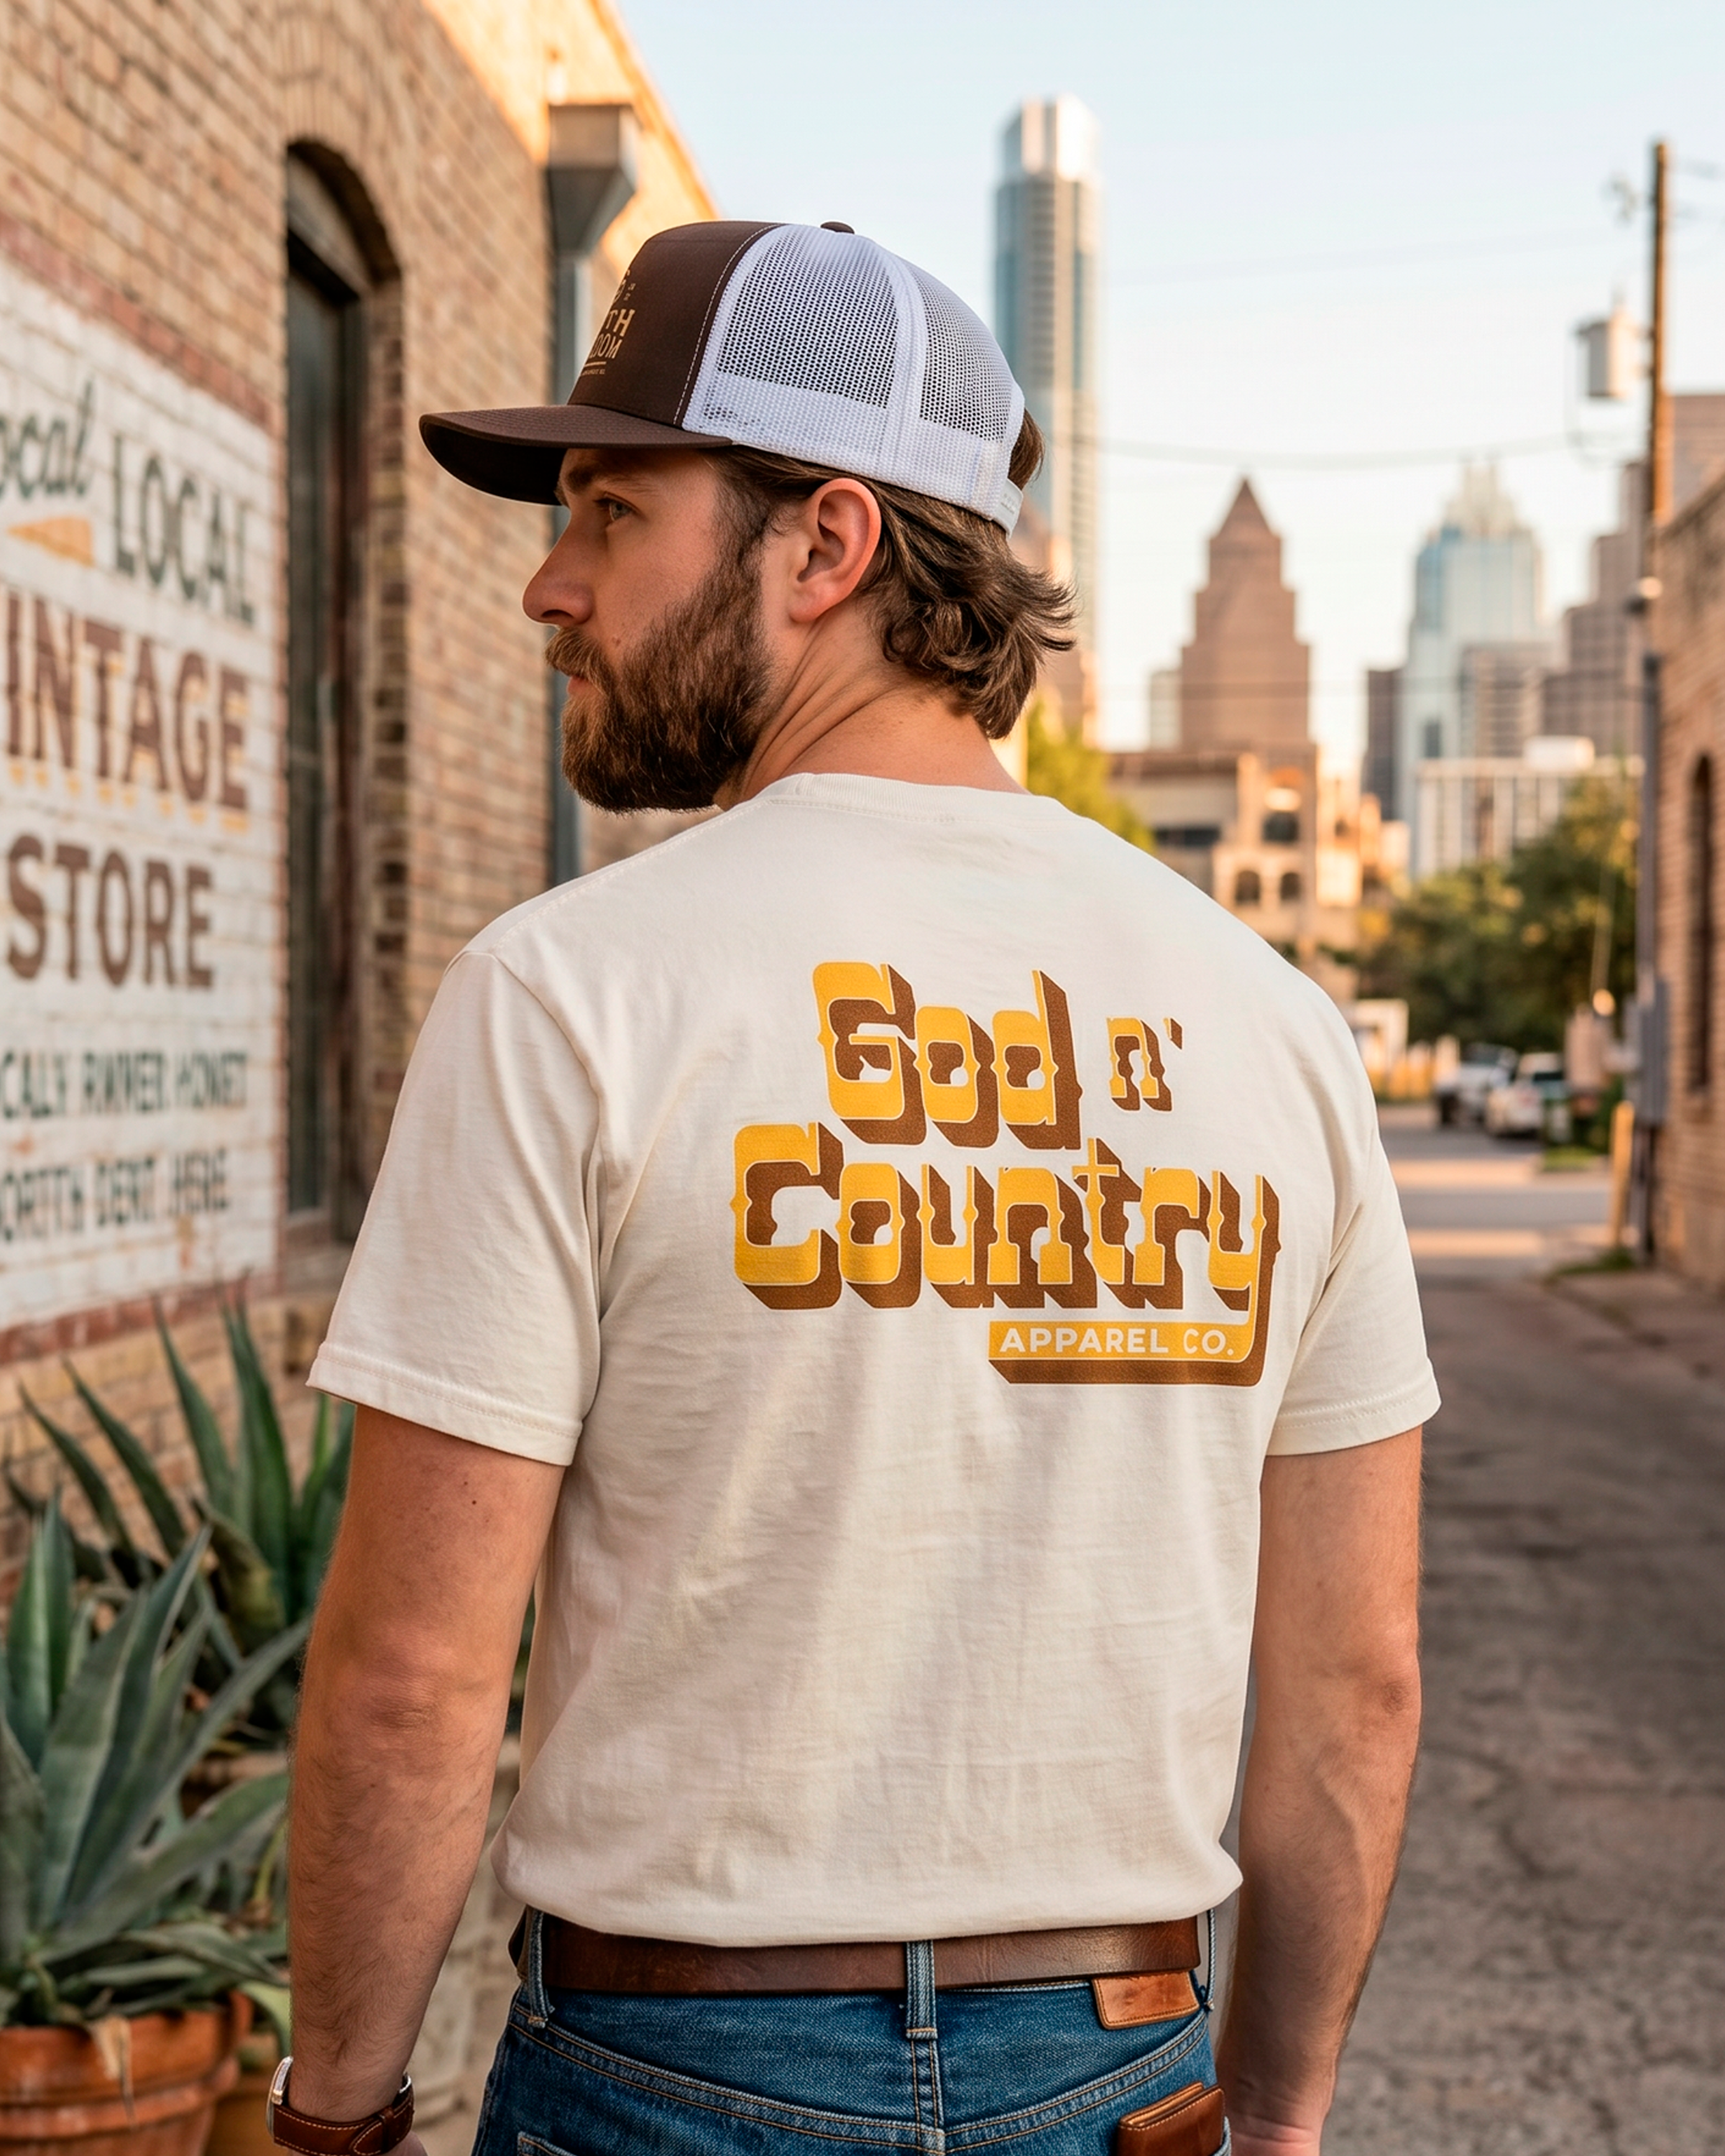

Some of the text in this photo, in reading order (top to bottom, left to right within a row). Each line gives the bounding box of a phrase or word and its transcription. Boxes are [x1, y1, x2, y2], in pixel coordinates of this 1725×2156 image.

[113, 433, 254, 627] LOCAL
[6, 588, 250, 812] INTAGE
[6, 834, 216, 990] STORE
[812, 961, 1083, 1150] God
[729, 1121, 1282, 1386] Country
[1000, 1327, 1235, 1357] APPAREL CO.
